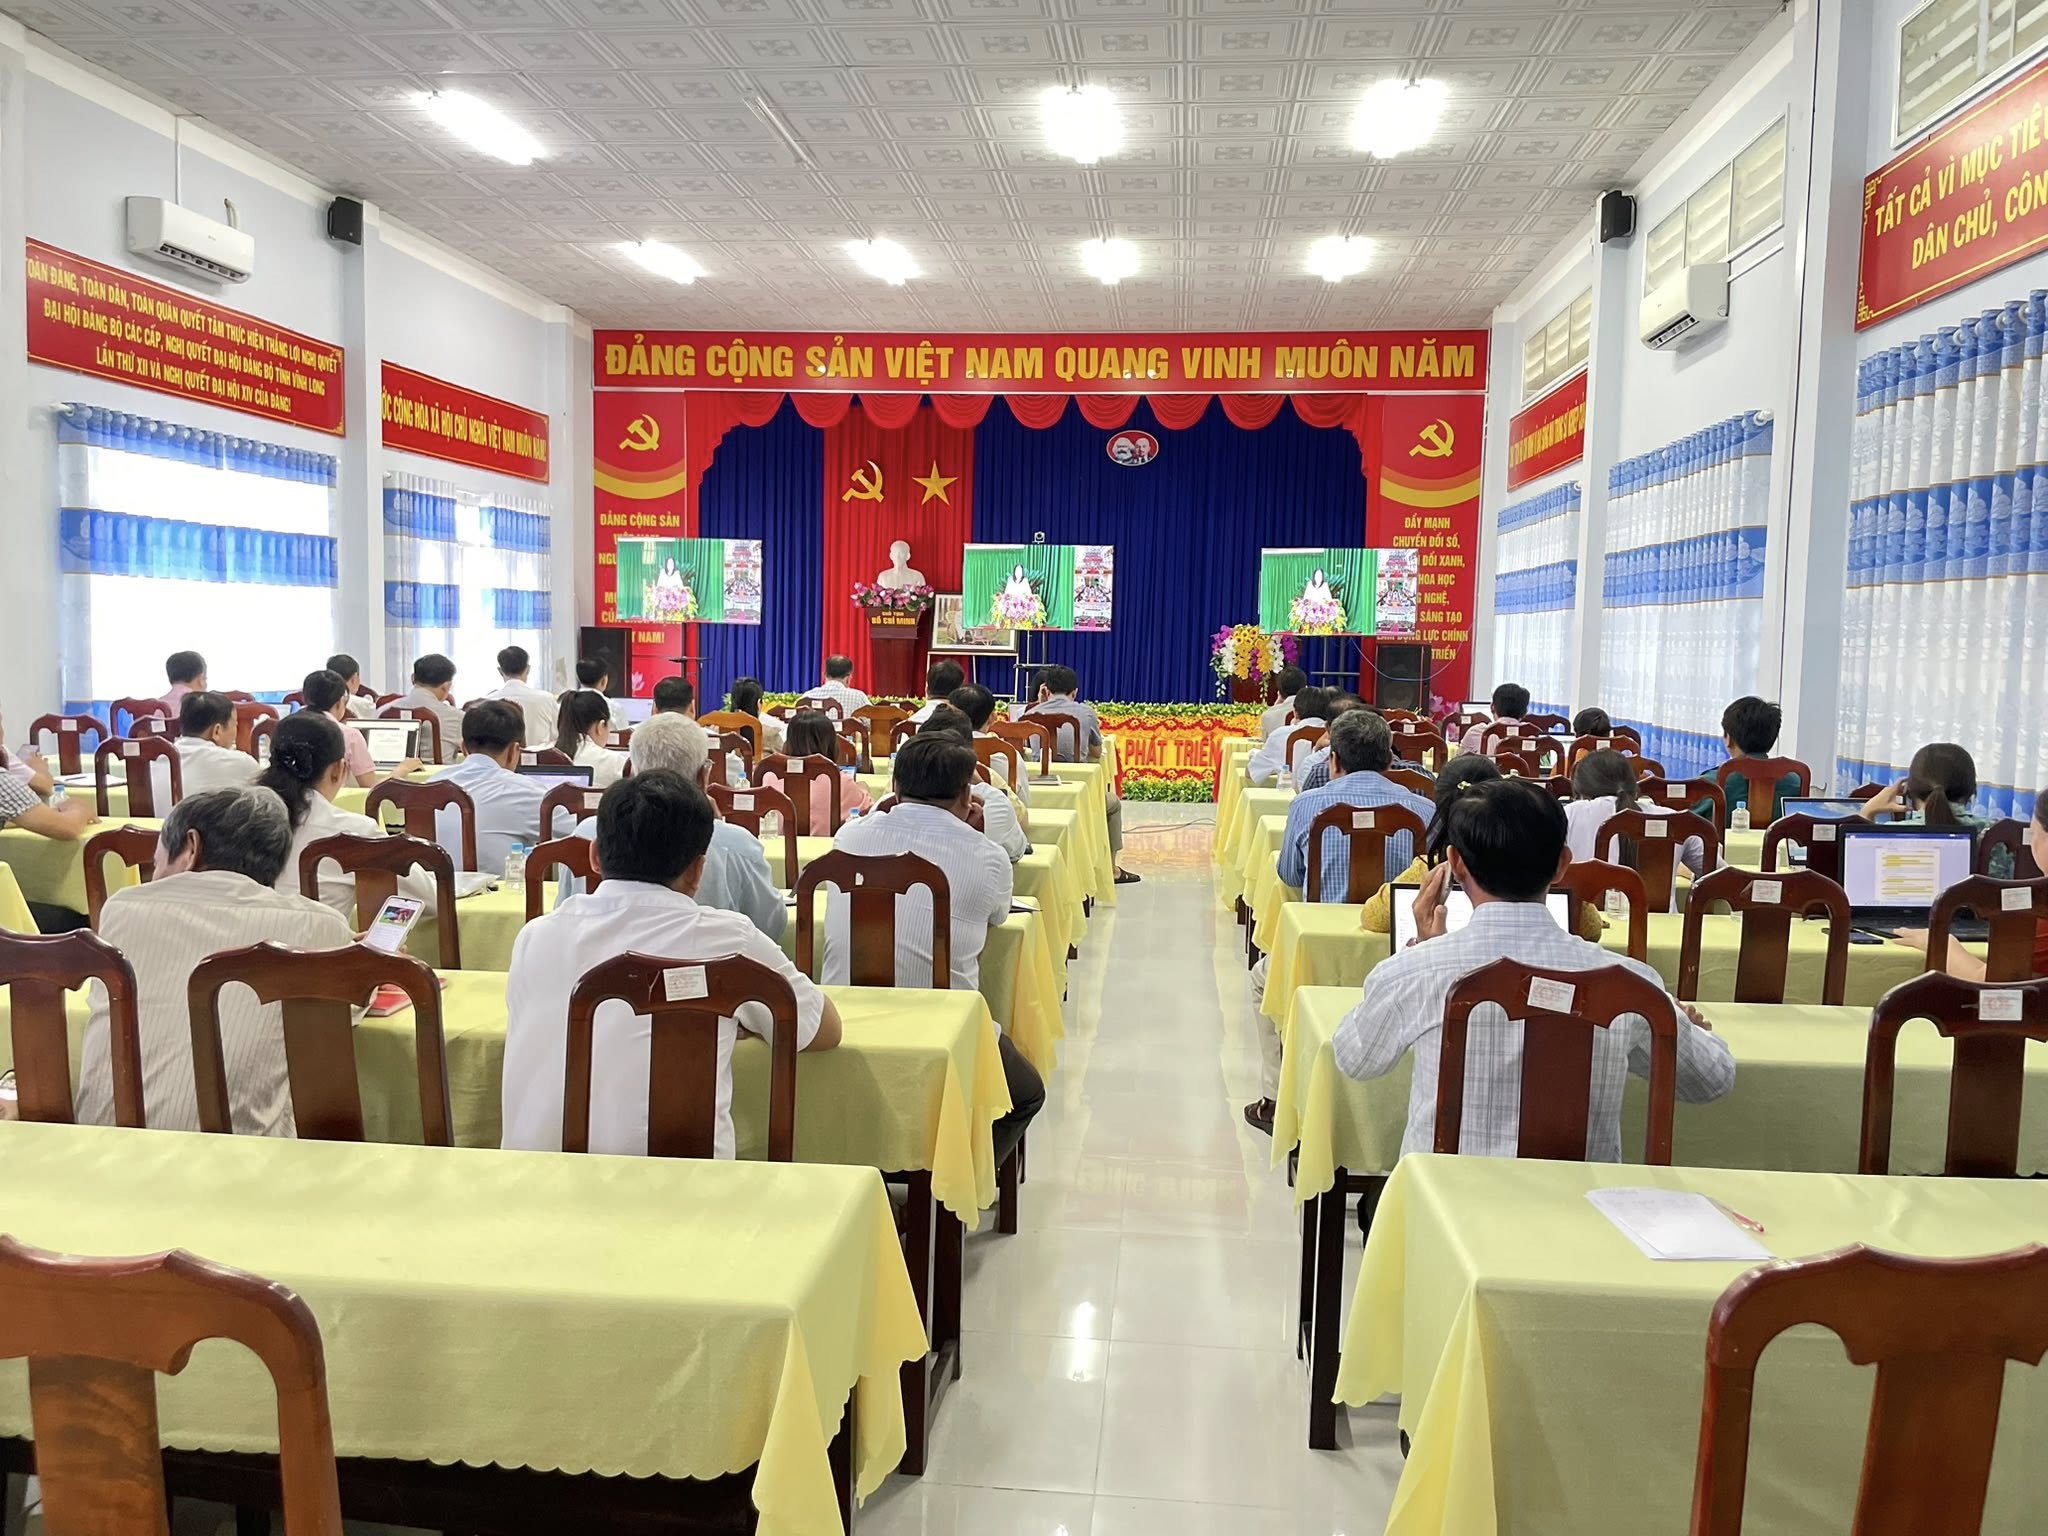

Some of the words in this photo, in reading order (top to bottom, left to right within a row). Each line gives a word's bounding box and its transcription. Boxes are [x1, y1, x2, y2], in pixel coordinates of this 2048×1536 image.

[1875, 186, 1906, 237] TẤT
[1909, 165, 1932, 218] CẢ
[1938, 155, 1954, 201] VÌ
[1960, 134, 2003, 189] MỤC
[1911, 222, 1948, 270] DÂN
[1953, 188, 1998, 249] CHỦ,
[26, 256, 48, 282] OÀN
[81, 276, 106, 301] TOÀN
[131, 291, 154, 316] TOÀN
[156, 300, 178, 324] QUÂN
[180, 309, 206, 332] QUYẾT
[207, 315, 224, 338] TÂM
[226, 323, 246, 346] THỰC
[44, 298, 61, 324] ĐẠI
[64, 302, 81, 328] HỘI
[82, 304, 108, 334] ĐẢNG
[110, 315, 122, 341] BỘ
[124, 320, 142, 344] CÁC
[165, 334, 185, 360] NGHỊ
[186, 340, 212, 363] QUYẾT
[213, 348, 227, 370] ĐẠI
[228, 350, 242, 374] HỘI
[308, 377, 326, 396] LONG
[605, 334, 696, 376] ĐẢNG
[706, 338, 793, 383] CỘNG
[806, 335, 873, 379] SẢN
[884, 340, 954, 386] VIỆT
[965, 346, 1044, 379] NAM
[1055, 346, 1170, 381] QUANG
[1182, 346, 1262, 379] VINH
[1275, 338, 1378, 379] MUÔN
[1389, 338, 1475, 379] NĂM
[136, 357, 148, 376] XII
[150, 358, 162, 380] VÀ
[184, 368, 210, 391] QUYẾT
[212, 377, 225, 398] ĐẠI
[227, 379, 240, 402] HỘI
[394, 390, 413, 430] CỘNG
[414, 396, 430, 432] HÒA
[600, 510, 628, 526] ĐẢNG
[630, 512, 656, 528] CỘNG
[660, 511, 680, 528] SẢN
[1424, 517, 1450, 531] MẠNH
[1439, 554, 1465, 568] XANH,
[1418, 574, 1436, 585] HOA
[1438, 574, 1456, 588] HỌC
[1420, 610, 1444, 622] SÁNG
[1446, 611, 1462, 624] TẠO
[638, 632, 664, 643] NAM!
[1423, 630, 1440, 644] LỰC
[1442, 628, 1468, 642] CHÍNH
[1124, 735, 1167, 766] PHÁT
